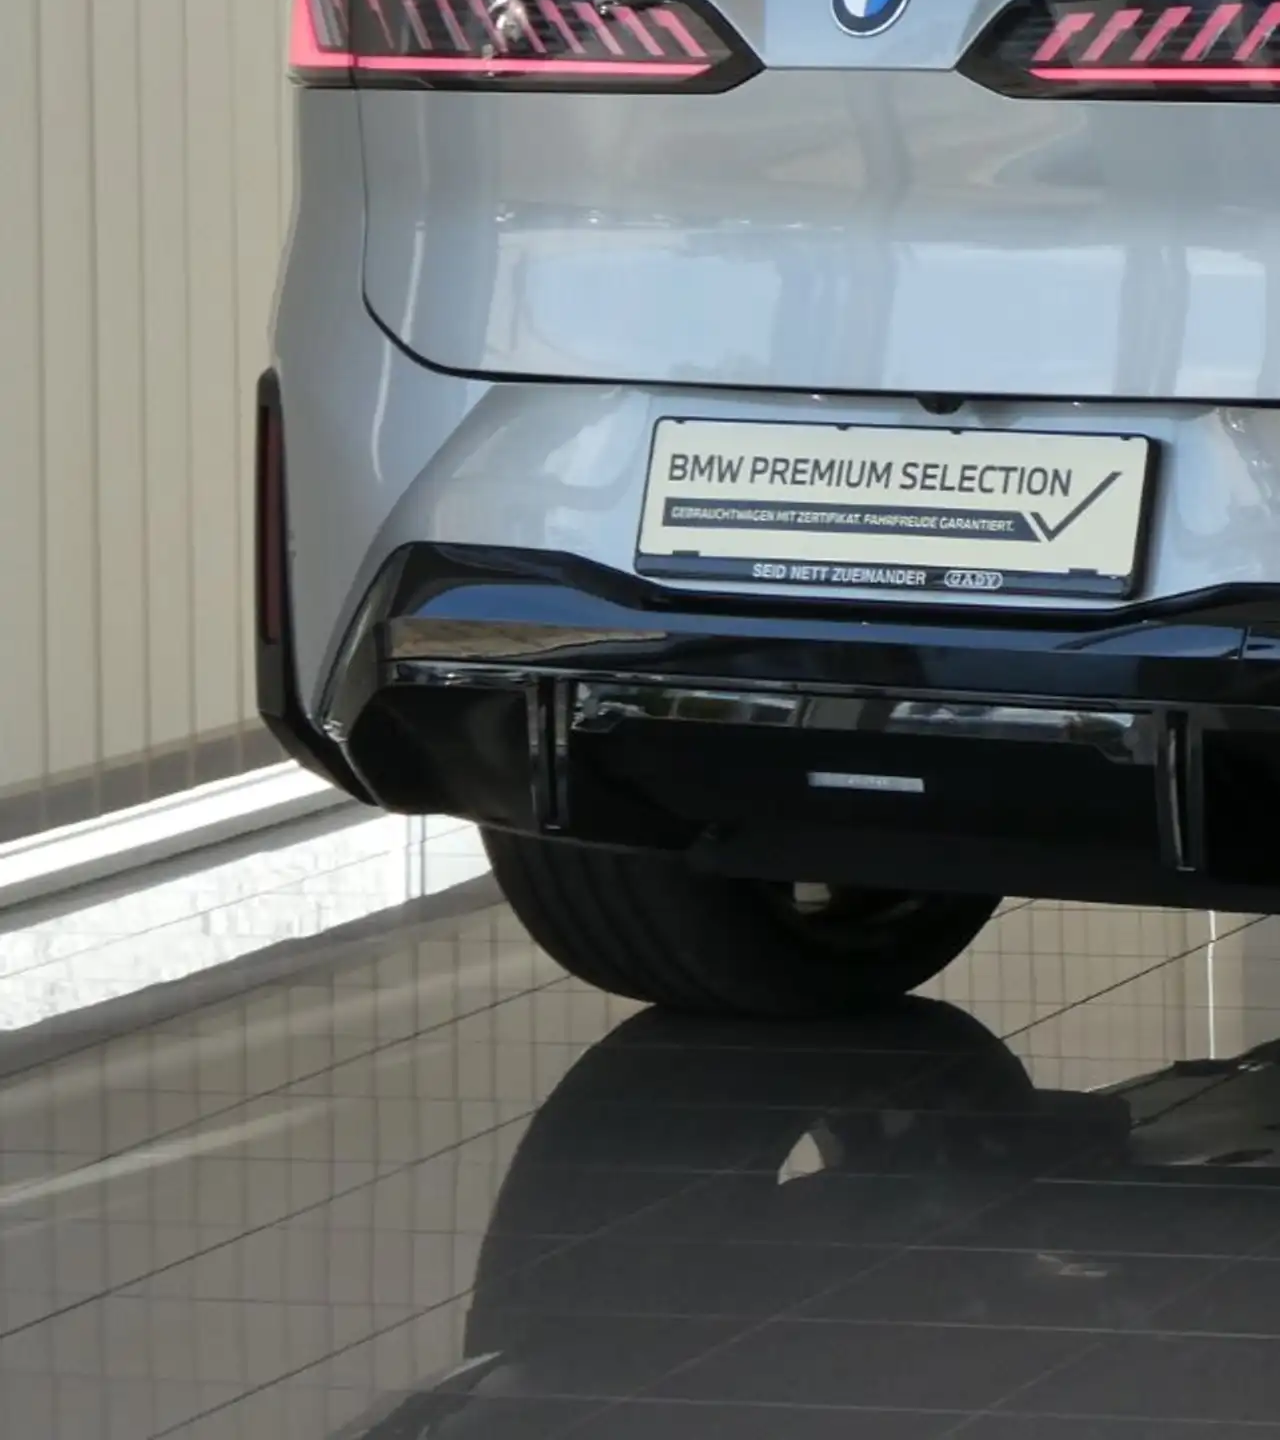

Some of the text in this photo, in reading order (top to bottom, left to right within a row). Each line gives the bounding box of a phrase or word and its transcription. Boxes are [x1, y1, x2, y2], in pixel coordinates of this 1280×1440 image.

[668, 454, 1072, 497] BMW PREMIUM SELECTION
[752, 563, 787, 579] SEID
[790, 565, 828, 581] NETT
[831, 567, 927, 586] ZUEINANDER
